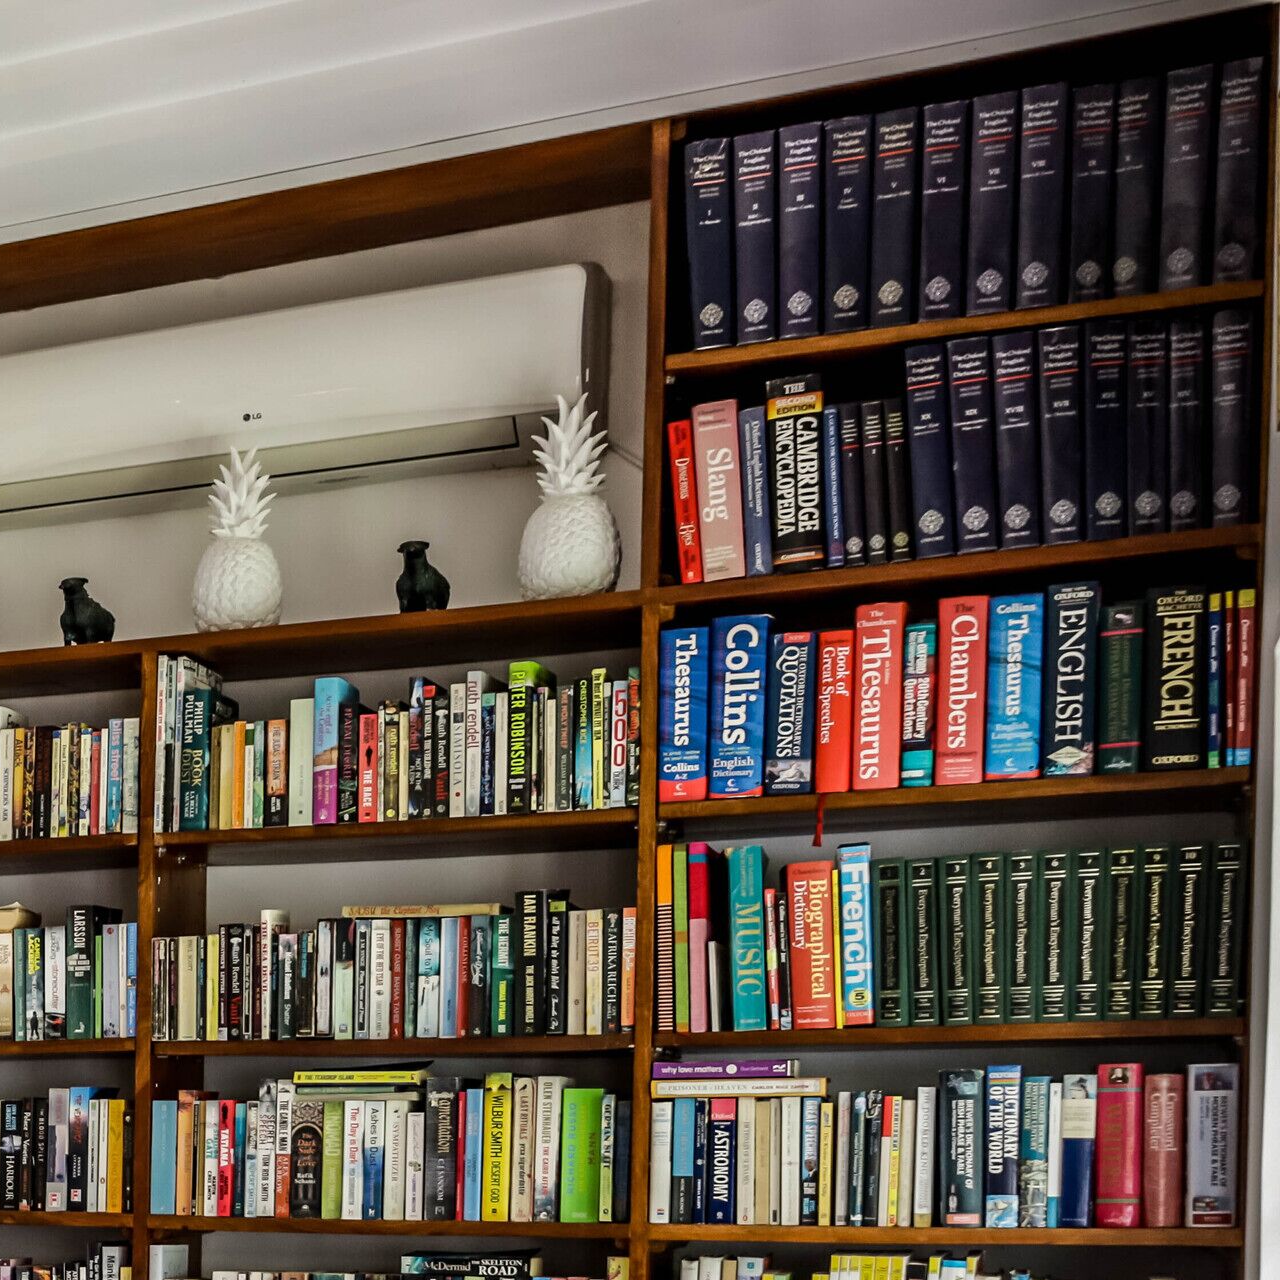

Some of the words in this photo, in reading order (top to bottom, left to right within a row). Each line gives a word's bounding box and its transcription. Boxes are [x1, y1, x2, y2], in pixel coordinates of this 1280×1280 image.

[776, 405, 816, 414] EDITION
[783, 383, 805, 393] THE
[703, 447, 734, 522] Slang
[776, 420, 795, 537] ENCYCLOPEDIA
[797, 416, 819, 532] CAMBRIDGE
[997, 603, 1036, 614] Collins
[1054, 591, 1094, 599] OXFORD
[1157, 594, 1203, 605] OXFORD
[723, 624, 760, 745] Collins
[822, 646, 835, 680] Great
[836, 646, 850, 680] Book
[948, 615, 979, 749] Chambers
[1006, 615, 1029, 716] Thesaurus
[1056, 607, 1087, 741] ENGLISH
[1161, 617, 1193, 718] FRENCH
[468, 681, 478, 702] ruth
[674, 634, 697, 747] Thesaurus
[776, 646, 799, 758] QUOTATIONS
[860, 629, 891, 779] Thesaurus
[183, 695, 194, 743] PULLMAN
[194, 701, 203, 734] PHILIP
[468, 704, 478, 748] rendell
[614, 690, 626, 767] 500
[820, 682, 834, 744] Speeches
[452, 725, 461, 786] SIMISOLA
[512, 717, 525, 776] ROBINSON
[664, 763, 699, 772] Collins
[713, 757, 754, 769] English
[1152, 754, 1198, 764] OXFORD
[363, 769, 372, 782] THE
[713, 768, 754, 778] Dictionary
[363, 785, 371, 809] RACE
[74, 910, 85, 948] LARSSON
[500, 918, 509, 934] THE
[524, 918, 536, 956] RANKIN
[792, 881, 805, 950] Dictionary
[841, 863, 871, 984] French
[500, 937, 509, 966] HERMIT
[736, 902, 761, 996] MUSIC
[806, 878, 831, 1000] Biographical
[661, 1065, 677, 1074] why
[679, 1065, 692, 1073] love
[694, 1065, 722, 1073] matters
[370, 1108, 378, 1132] Ashes
[493, 1095, 504, 1126] WILBUR
[1004, 1085, 1017, 1160] DICTIONARY
[492, 1130, 503, 1158] SMITH
[990, 1131, 1003, 1174] WORLD
[6, 1156, 14, 1200] HARBOUR
[714, 1130, 728, 1202] ASTRONOMY
[424, 1262, 472, 1272] McDermid
[479, 1266, 518, 1276] ROAD
